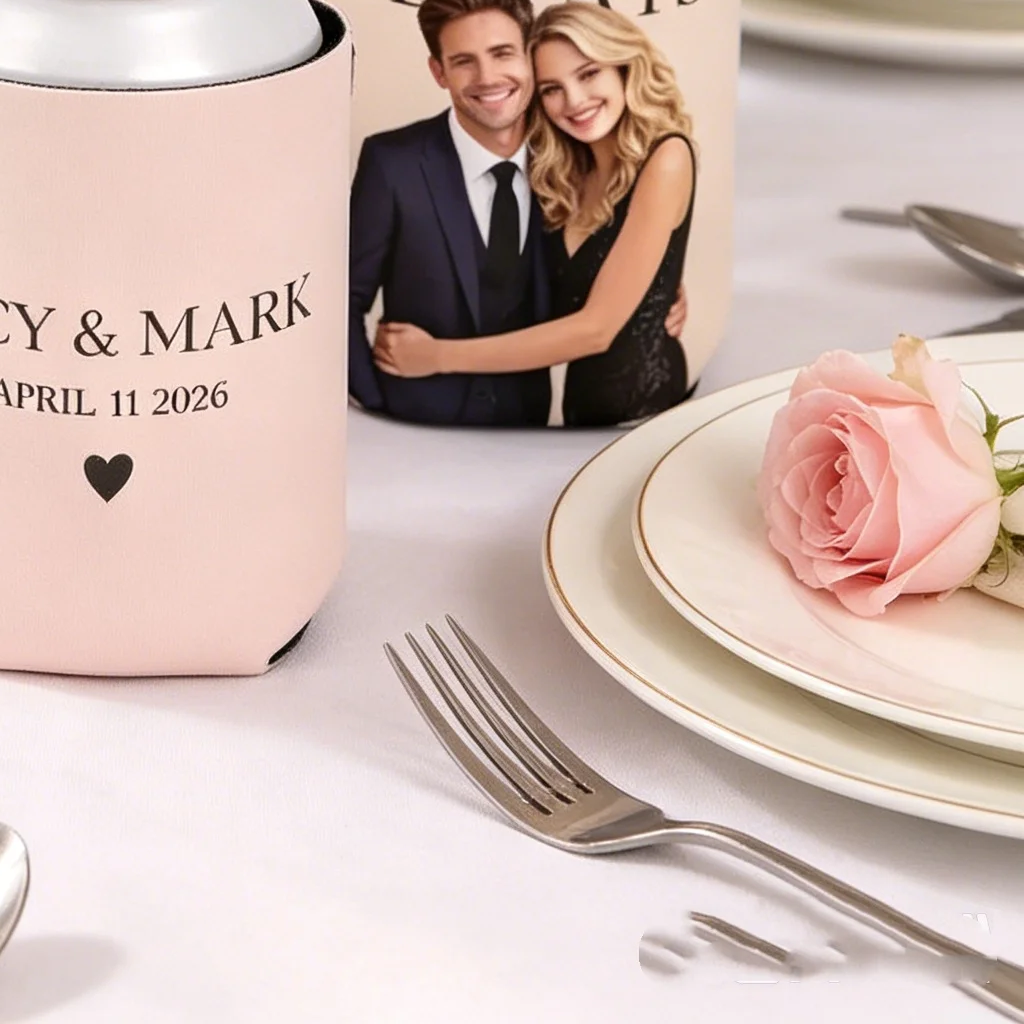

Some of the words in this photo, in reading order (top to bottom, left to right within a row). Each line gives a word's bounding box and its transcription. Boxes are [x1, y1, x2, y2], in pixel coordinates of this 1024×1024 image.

[74, 309, 119, 358] &
[139, 272, 312, 356] MARK
[110, 389, 140, 418] 11
[152, 379, 230, 416] 2026
